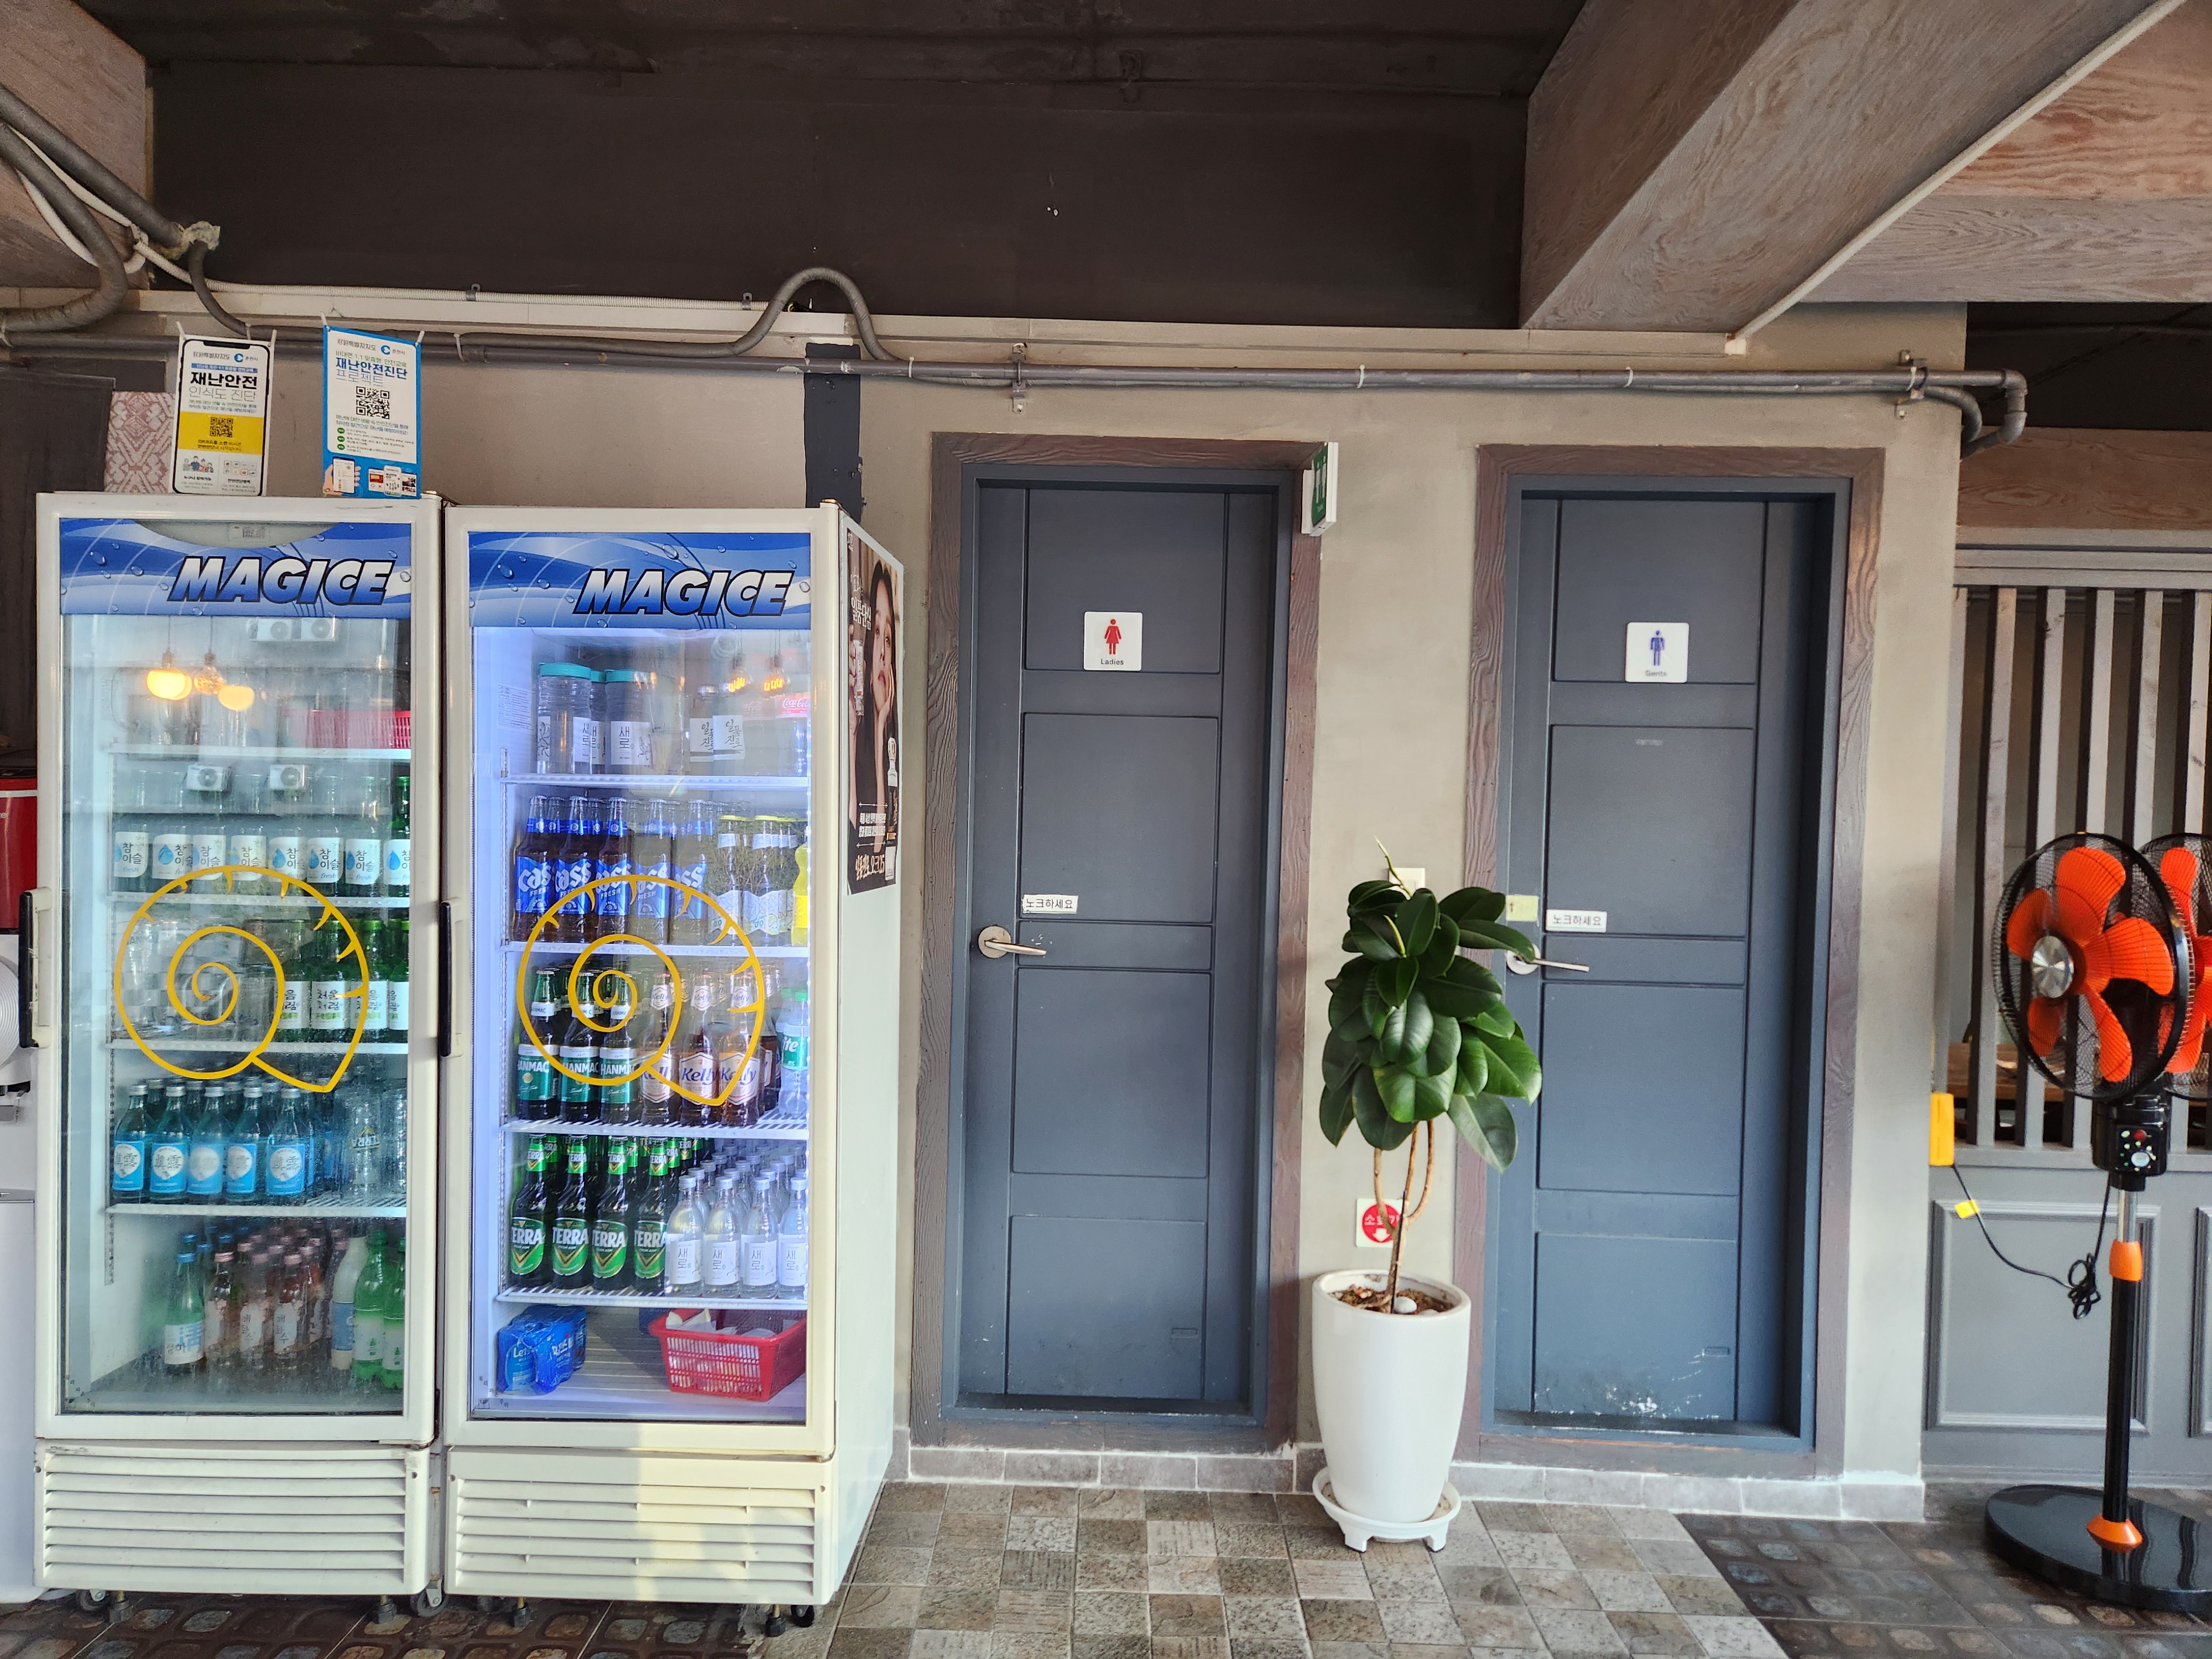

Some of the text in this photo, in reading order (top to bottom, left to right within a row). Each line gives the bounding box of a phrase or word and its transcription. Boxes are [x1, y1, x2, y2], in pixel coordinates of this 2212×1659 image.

[336, 357, 408, 380] 재난안전진단
[384, 359, 406, 367] 안전교육
[190, 372, 257, 389] 재난안전
[336, 369, 383, 387] 프로젝트
[189, 386, 255, 402] 인식도 진단
[167, 555, 395, 606] MAGICE
[573, 568, 794, 617] MAGICE
[601, 888, 621, 899] FRESH
[1026, 899, 1073, 909] 노크하세요
[1553, 915, 1601, 926] 노크하세요
[681, 1067, 718, 1085] Kelly
[553, 1227, 589, 1244] TERRA
[677, 1248, 688, 1269] 새로
[712, 1249, 722, 1270] 새로
[751, 1250, 761, 1270] 새로
[786, 1250, 796, 1270] 새로
